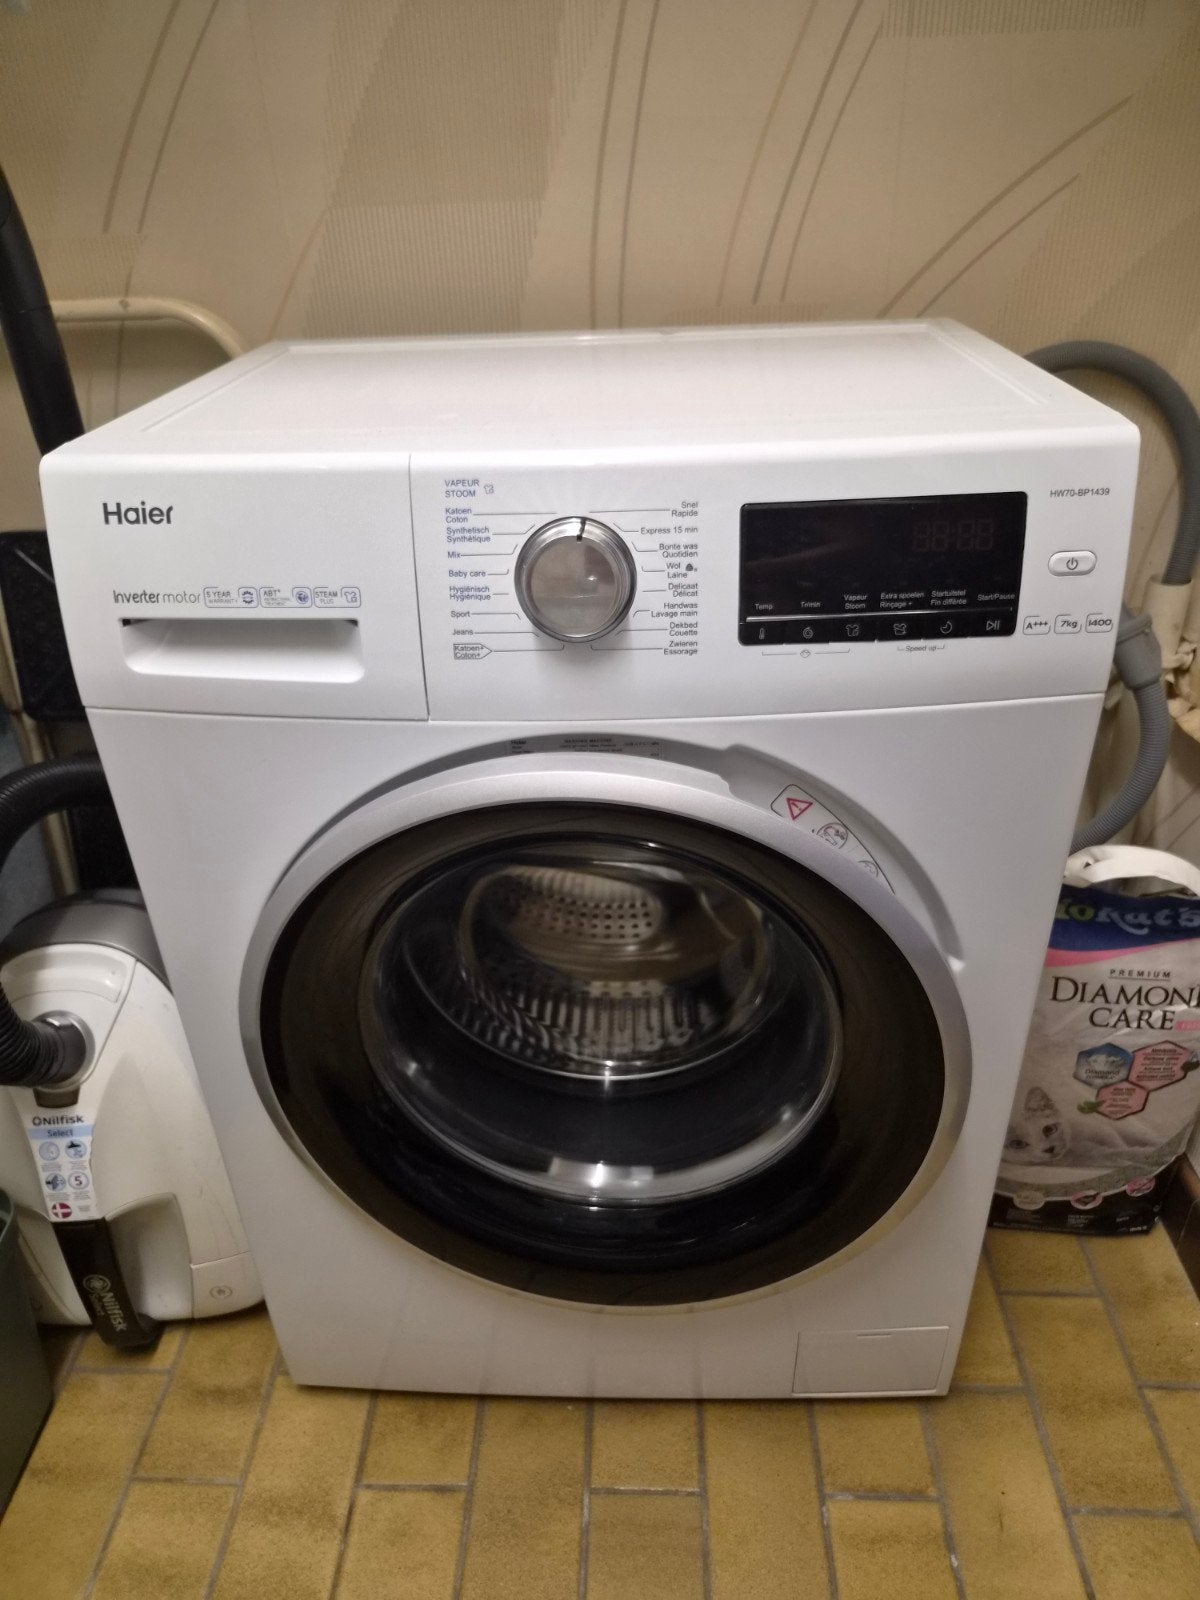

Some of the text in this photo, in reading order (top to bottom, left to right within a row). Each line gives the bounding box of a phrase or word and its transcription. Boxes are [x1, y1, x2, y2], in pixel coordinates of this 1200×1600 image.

[444, 479, 480, 487] VAPEUR
[444, 490, 476, 498] STOOM
[1049, 487, 1111, 498] HW70-BP1439
[680, 501, 699, 509] Snel
[102, 501, 173, 525] Haier
[444, 507, 473, 516] Katoen
[671, 509, 699, 518] Rapide
[445, 516, 469, 524] Coton
[446, 526, 490, 536] Synthetisch
[640, 526, 699, 536] Express 15 min
[659, 542, 680, 551] Bonte
[447, 551, 461, 560] Mix
[662, 550, 699, 559] Quotidien
[666, 562, 682, 570] Wol
[448, 569, 487, 579] Baby care
[667, 571, 688, 579] Laine
[668, 582, 699, 591] Delicaat
[112, 590, 201, 604] Inverter motor
[843, 592, 868, 602] Vapeur
[880, 591, 925, 600] Extra spoelen
[977, 593, 1016, 601] Start/Pause
[663, 602, 699, 610] Handwas
[754, 602, 774, 612] Temp
[844, 601, 867, 610] Stoom
[450, 610, 471, 619] Sport
[650, 610, 699, 619] Lavage main
[669, 621, 699, 629] Dekbed
[1026, 621, 1048, 631] A+++
[1060, 620, 1078, 629] 7kg
[1088, 618, 1113, 627] 1400
[452, 628, 475, 636] Jeans
[668, 629, 699, 637] Couette
[668, 640, 699, 648] Zwieren
[663, 648, 699, 657] Essorage
[1109, 968, 1172, 978] PREMIUM
[1050, 975, 1200, 1009] DIAMON
[1088, 1007, 1176, 1031] CARE
[47, 1128, 74, 1138] Select
[74, 1175, 83, 1186] 5
